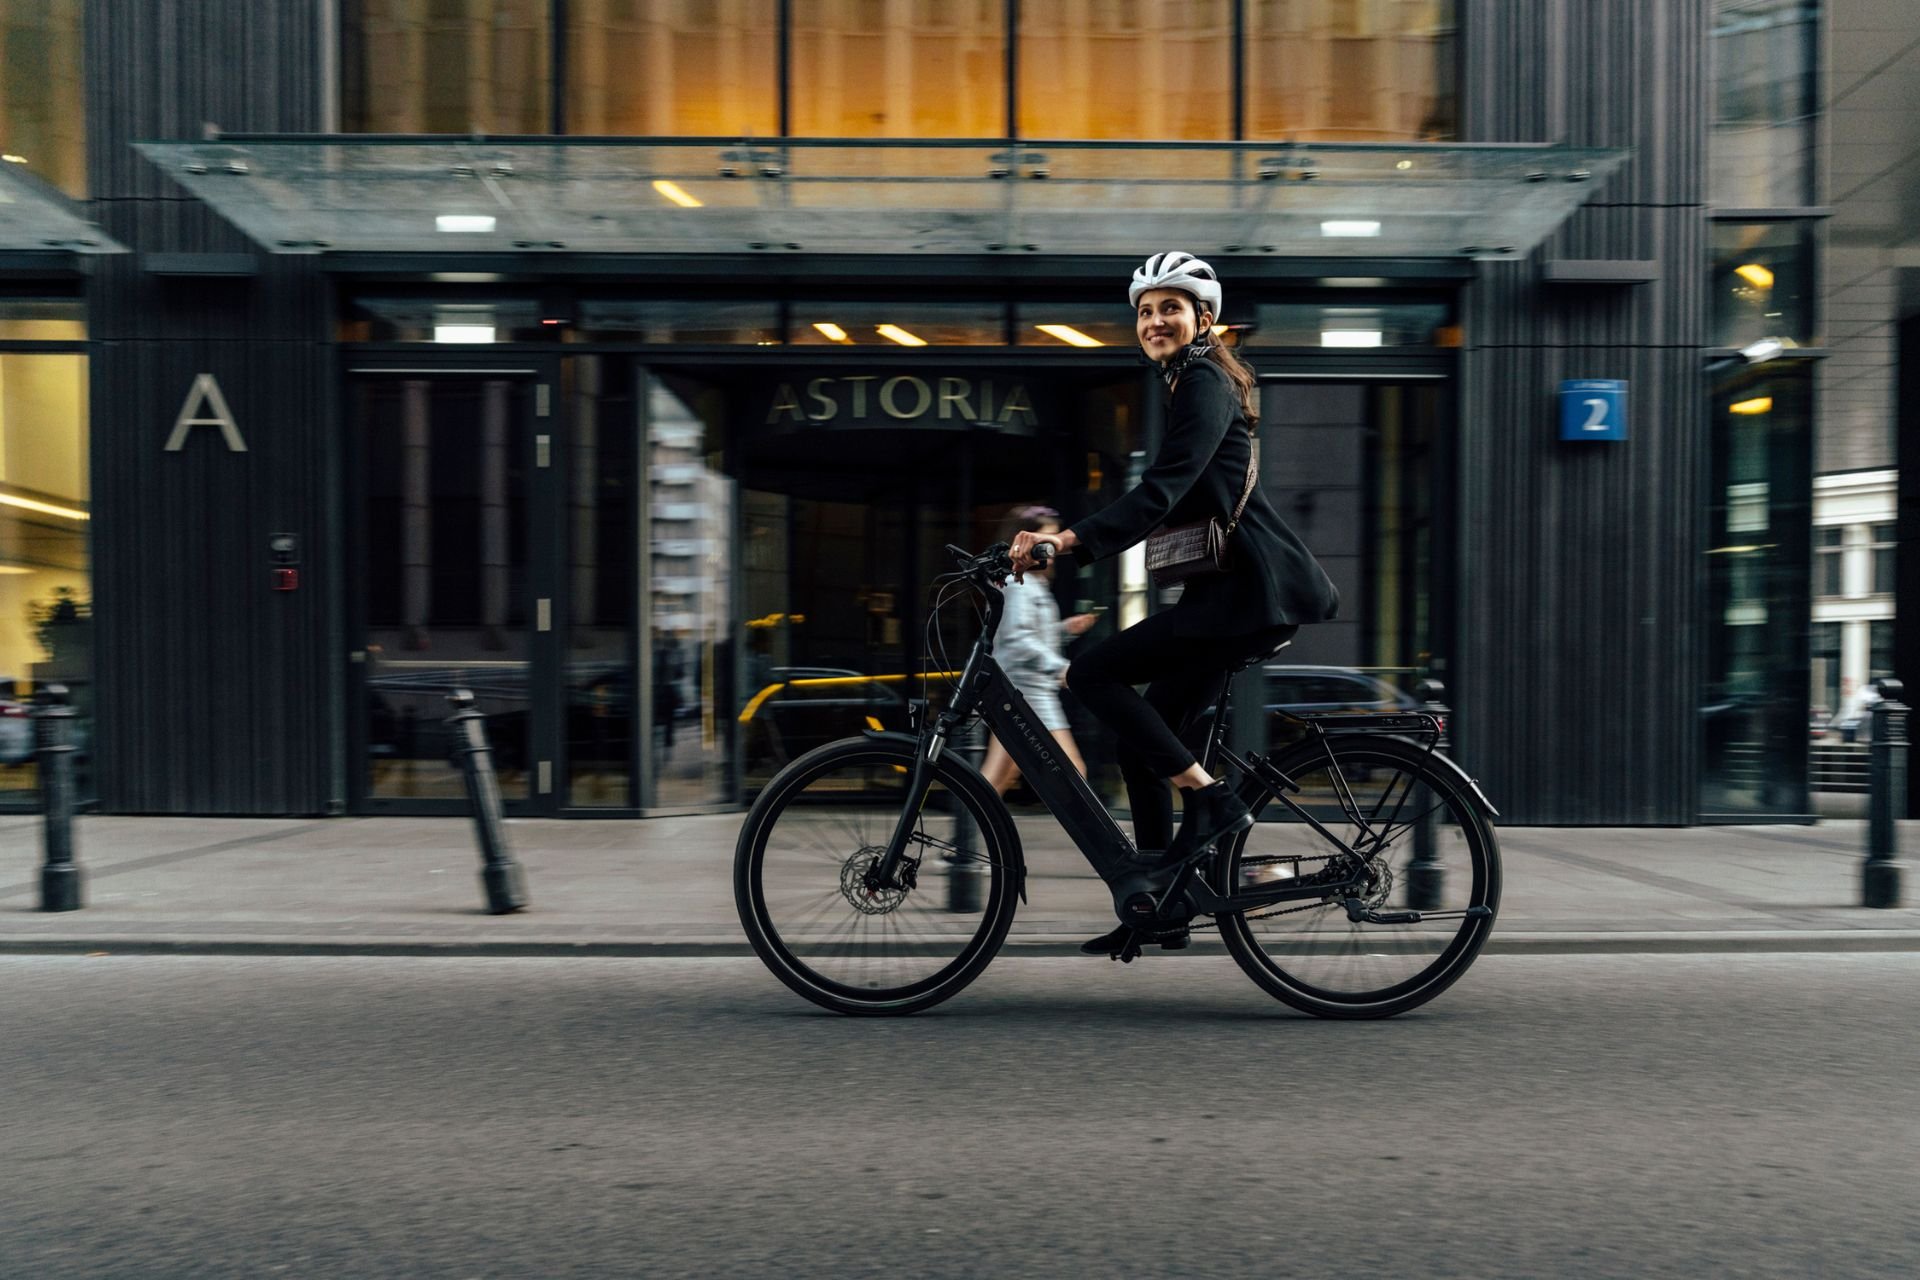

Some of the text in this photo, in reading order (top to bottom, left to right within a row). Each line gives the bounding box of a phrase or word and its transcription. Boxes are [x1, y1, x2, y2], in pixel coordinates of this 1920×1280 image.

[164, 373, 248, 451] A
[765, 375, 1039, 425] ASTORIA
[1583, 398, 1610, 431] 2
[1012, 713, 1061, 773] KALKHOFF
